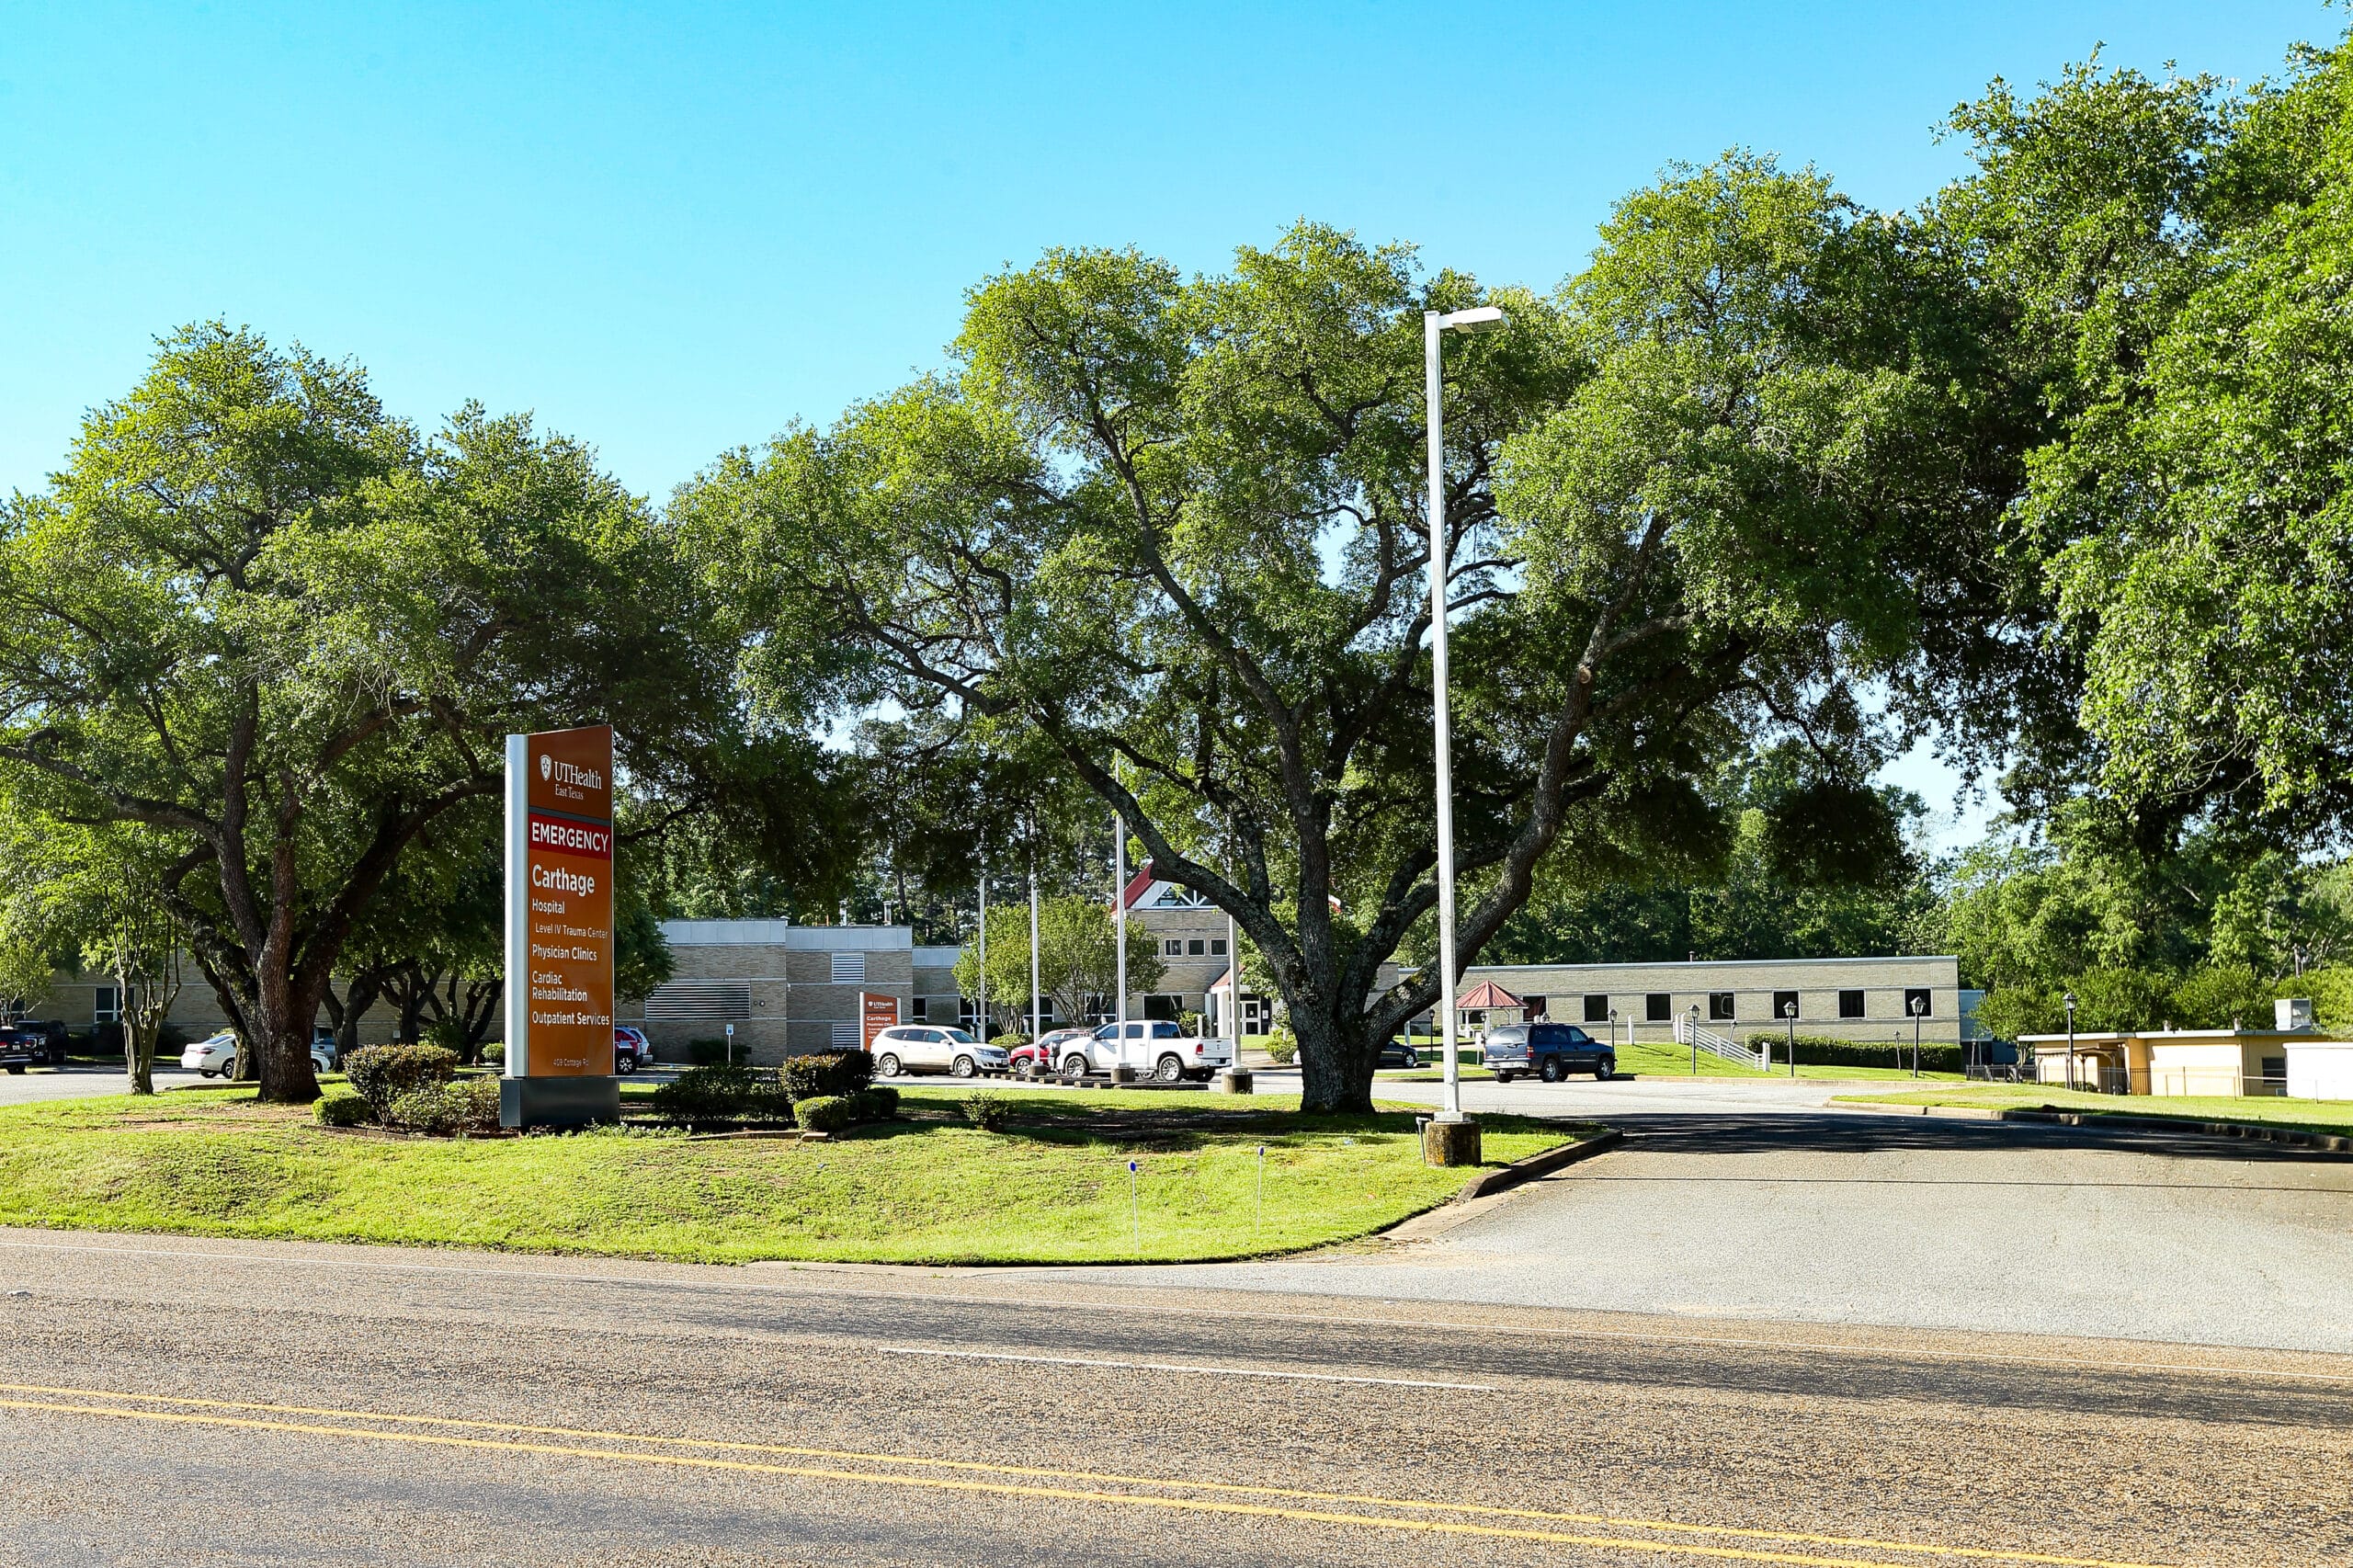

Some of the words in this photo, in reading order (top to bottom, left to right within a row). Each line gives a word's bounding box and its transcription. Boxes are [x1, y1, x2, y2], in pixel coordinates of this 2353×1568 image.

[553, 761, 602, 790] UTHealth
[555, 784, 567, 796] East
[568, 787, 584, 800] Texas
[531, 822, 609, 853] EMERGENCY
[532, 864, 596, 896] Carthage
[532, 899, 565, 915] Hospital
[535, 922, 553, 934] Level
[554, 924, 562, 934] IV
[563, 925, 586, 937] Trauma
[587, 927, 608, 938] Center
[532, 943, 570, 960] Physician
[572, 946, 597, 961] Clinics
[532, 970, 563, 985] Cardiac
[532, 986, 588, 1002] Rehabilitation
[532, 1011, 575, 1027] Outpatient
[576, 1012, 610, 1027] Services
